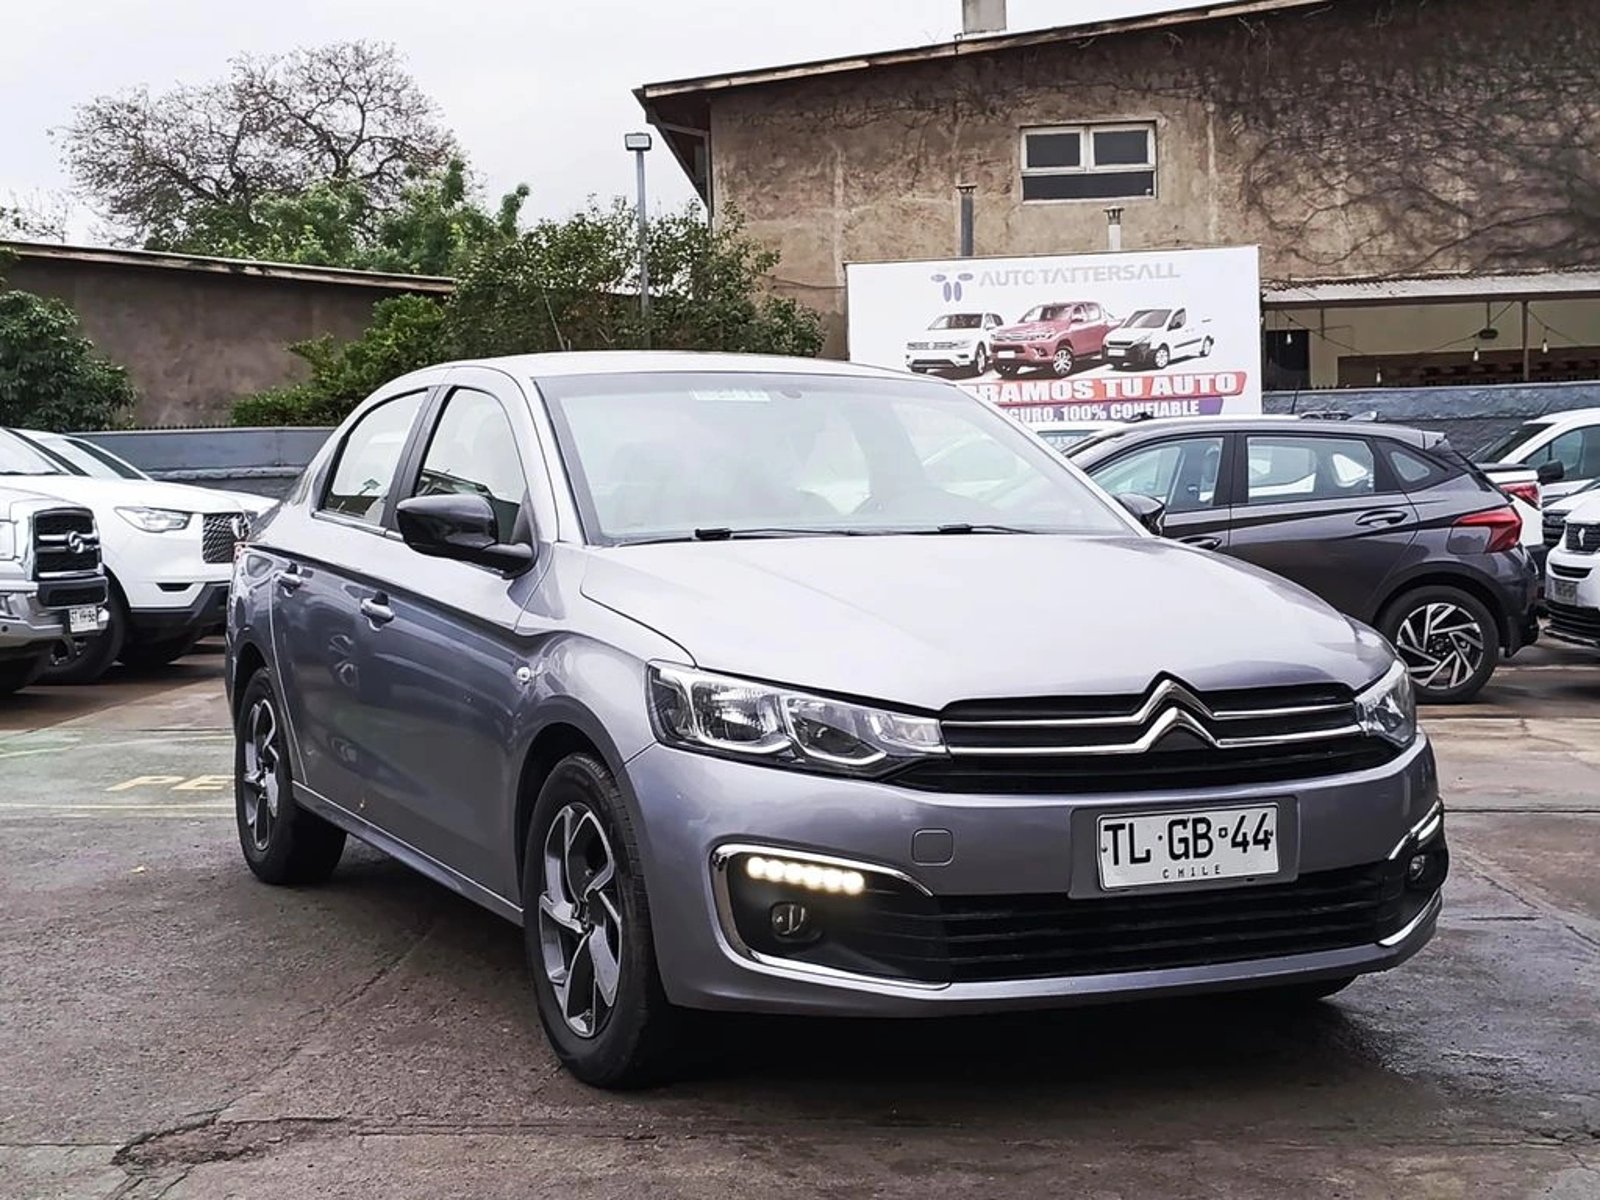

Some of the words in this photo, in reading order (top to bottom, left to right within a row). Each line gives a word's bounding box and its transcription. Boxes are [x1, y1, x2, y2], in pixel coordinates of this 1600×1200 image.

[979, 270, 1036, 287] AUTO
[1041, 263, 1181, 285] TATTERSALL
[1101, 378, 1144, 399] TU
[1150, 373, 1238, 397] AUTO
[1004, 406, 1059, 422] GURO,
[1061, 404, 1108, 421] 100%
[1162, 864, 1221, 879] CHILE
